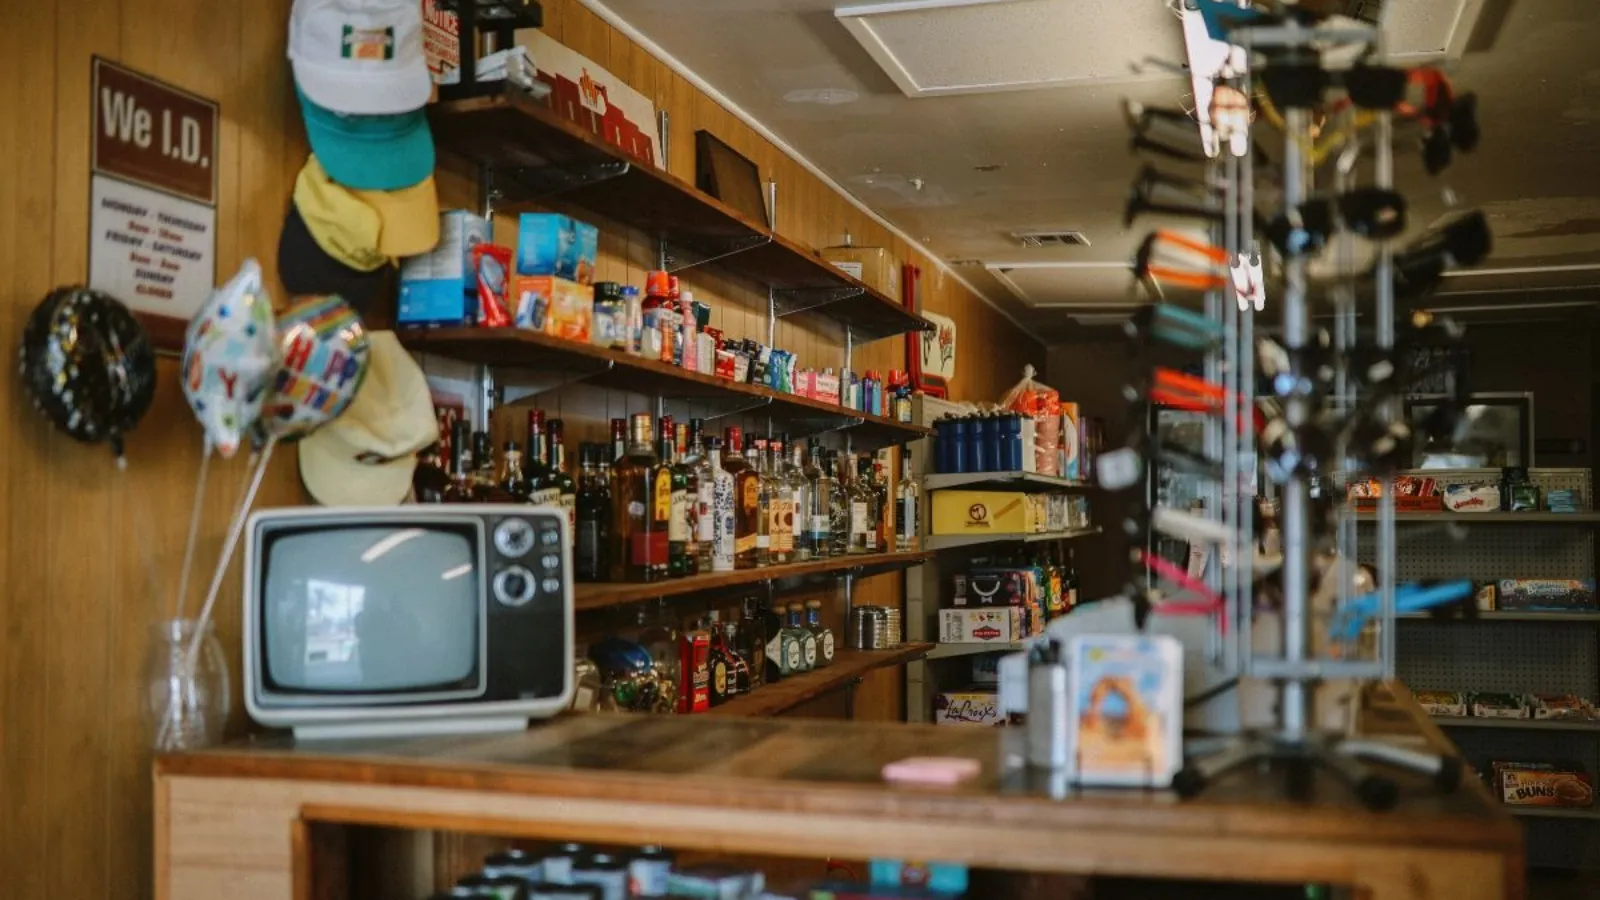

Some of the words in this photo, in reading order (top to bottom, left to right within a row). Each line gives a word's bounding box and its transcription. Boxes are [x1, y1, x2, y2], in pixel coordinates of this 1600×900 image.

[102, 86, 152, 149] We
[162, 107, 209, 168] I.D.
[102, 198, 147, 216] MONDAY
[158, 211, 206, 233] THURSDAY
[105, 230, 144, 247] FRIDAY
[153, 240, 202, 262] SATURDAY
[135, 268, 174, 284] SUNDAY
[136, 283, 173, 299] CLOSED
[1516, 784, 1554, 800] BUNS
